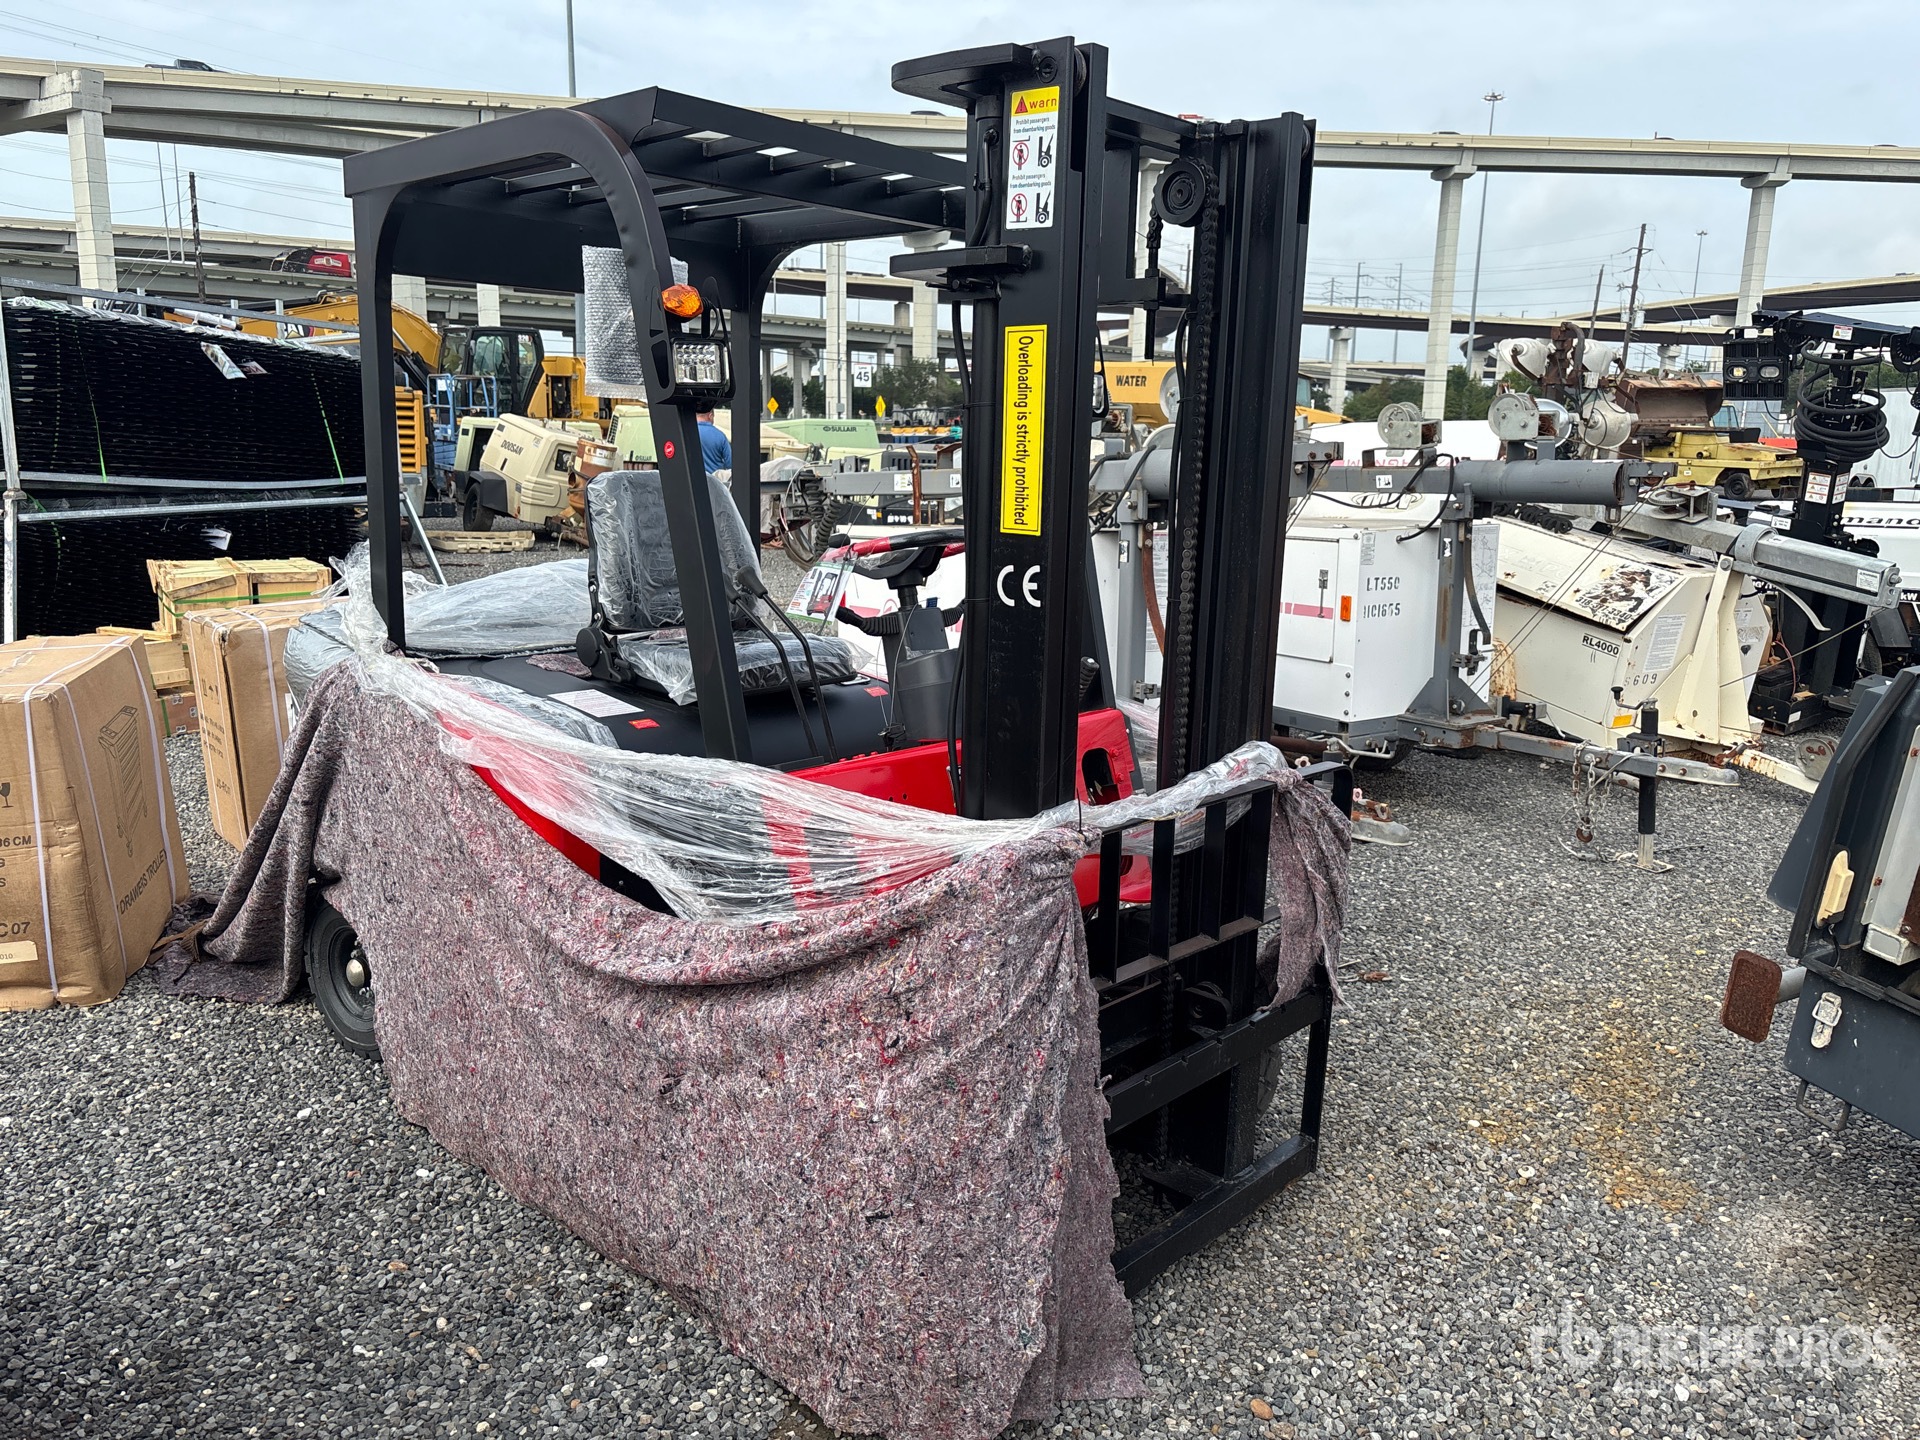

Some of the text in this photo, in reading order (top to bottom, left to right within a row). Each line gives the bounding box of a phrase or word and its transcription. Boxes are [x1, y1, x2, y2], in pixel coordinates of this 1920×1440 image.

[1029, 98, 1057, 110] warn
[856, 371, 870, 382] 45
[1115, 374, 1147, 387] WATER
[1012, 335, 1034, 526] Overloading is strictly prohibited
[500, 439, 524, 455] DOOSAN
[996, 564, 1042, 608] CE
[1900, 592, 1918, 601] kW
[1581, 635, 1620, 656] RL4000
[0, 835, 32, 848] 6 CM
[119, 872, 148, 915] DRAWERS
